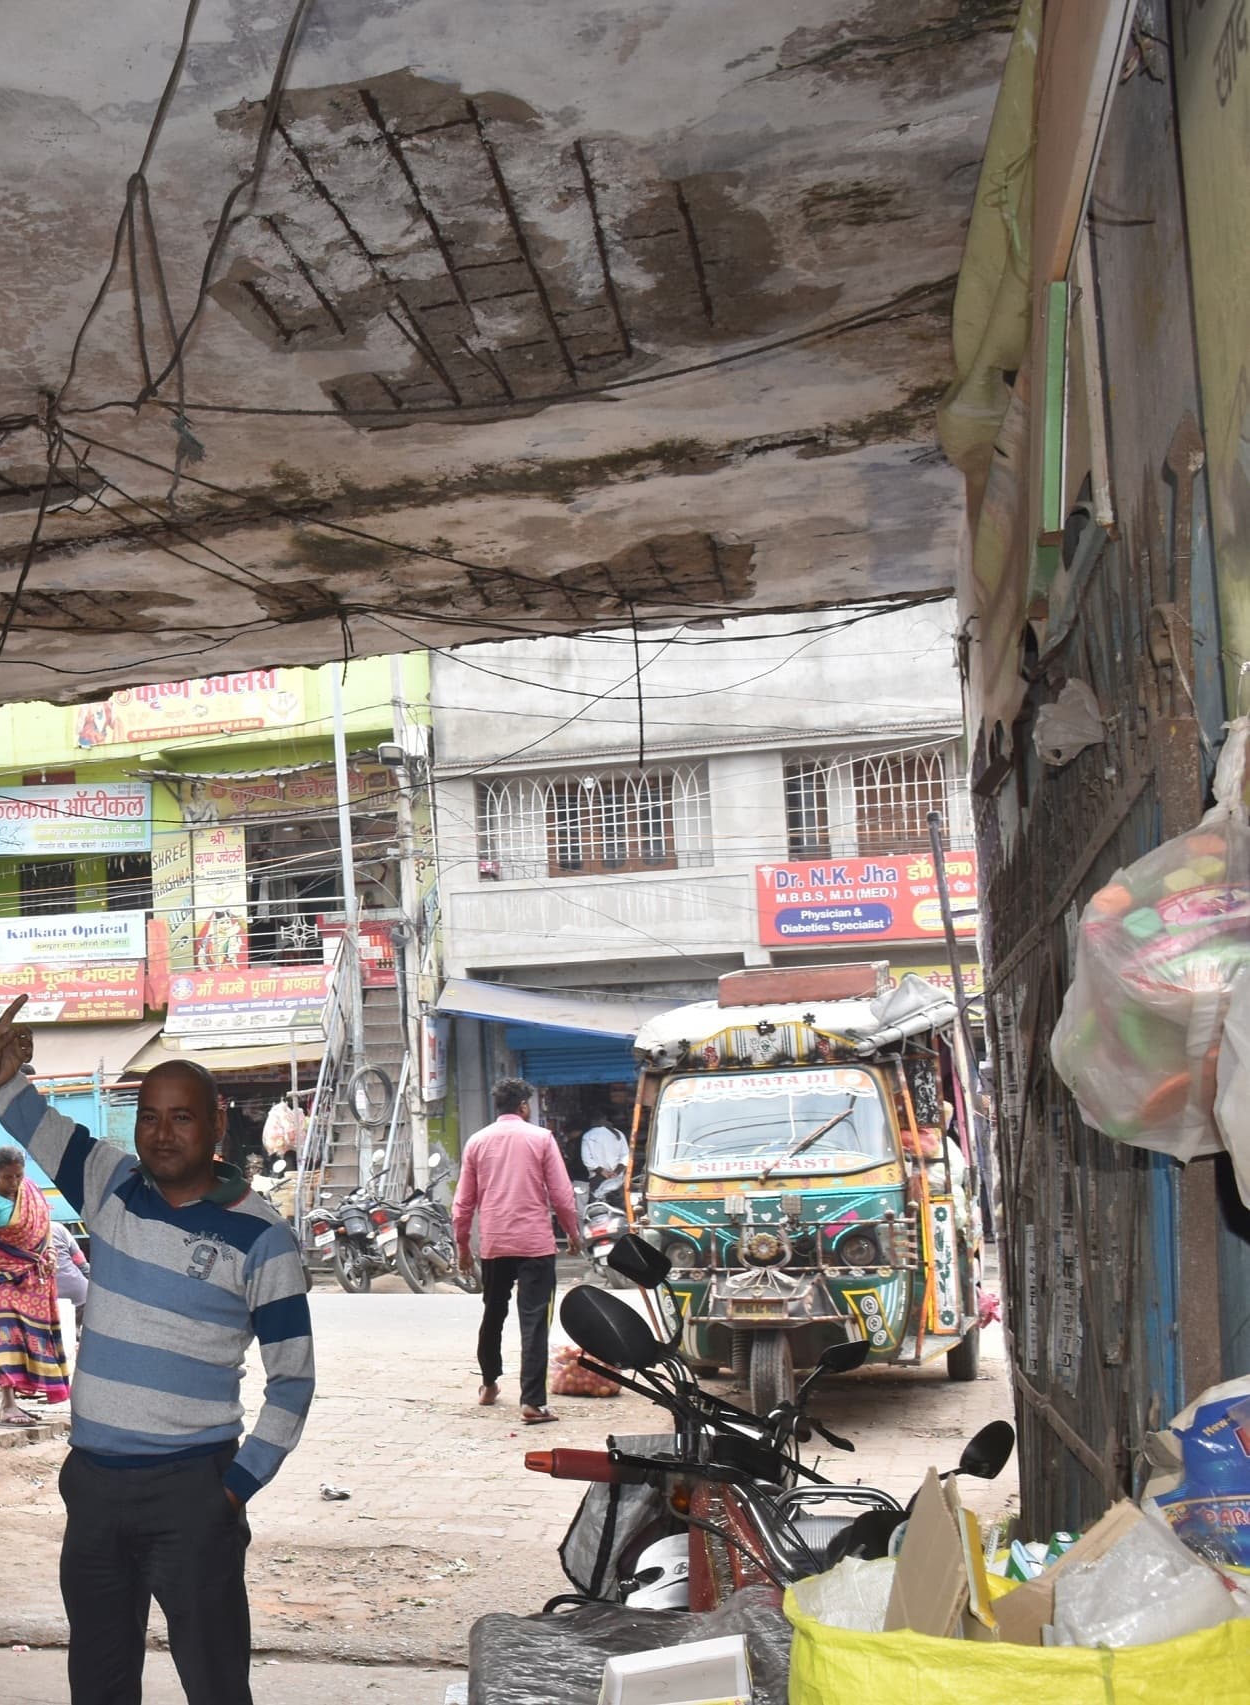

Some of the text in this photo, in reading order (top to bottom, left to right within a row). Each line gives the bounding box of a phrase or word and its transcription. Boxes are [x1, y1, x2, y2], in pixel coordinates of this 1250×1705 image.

[63, 789, 146, 819] ऑप्टीकल
[209, 830, 226, 845] श्री
[152, 841, 188, 871] SHREE
[194, 851, 215, 871] कृष्ण
[775, 863, 899, 890] Dr. N.K. Jha
[829, 890, 854, 902] M.D
[856, 886, 898, 900] (MED.)
[800, 907, 863, 921] Physician &
[6, 924, 68, 941] Kalkata
[72, 922, 129, 938] Optical
[831, 919, 885, 933] Specialist
[40, 968, 78, 991] पूजा
[82, 966, 138, 982] भण्डार
[197, 975, 324, 998] माँ अम्बे पूजा भण्डार
[701, 1073, 829, 1091] JAI MATA DI
[696, 1157, 832, 1174] SUPER FAST
[1202, 1416, 1231, 1437] New
